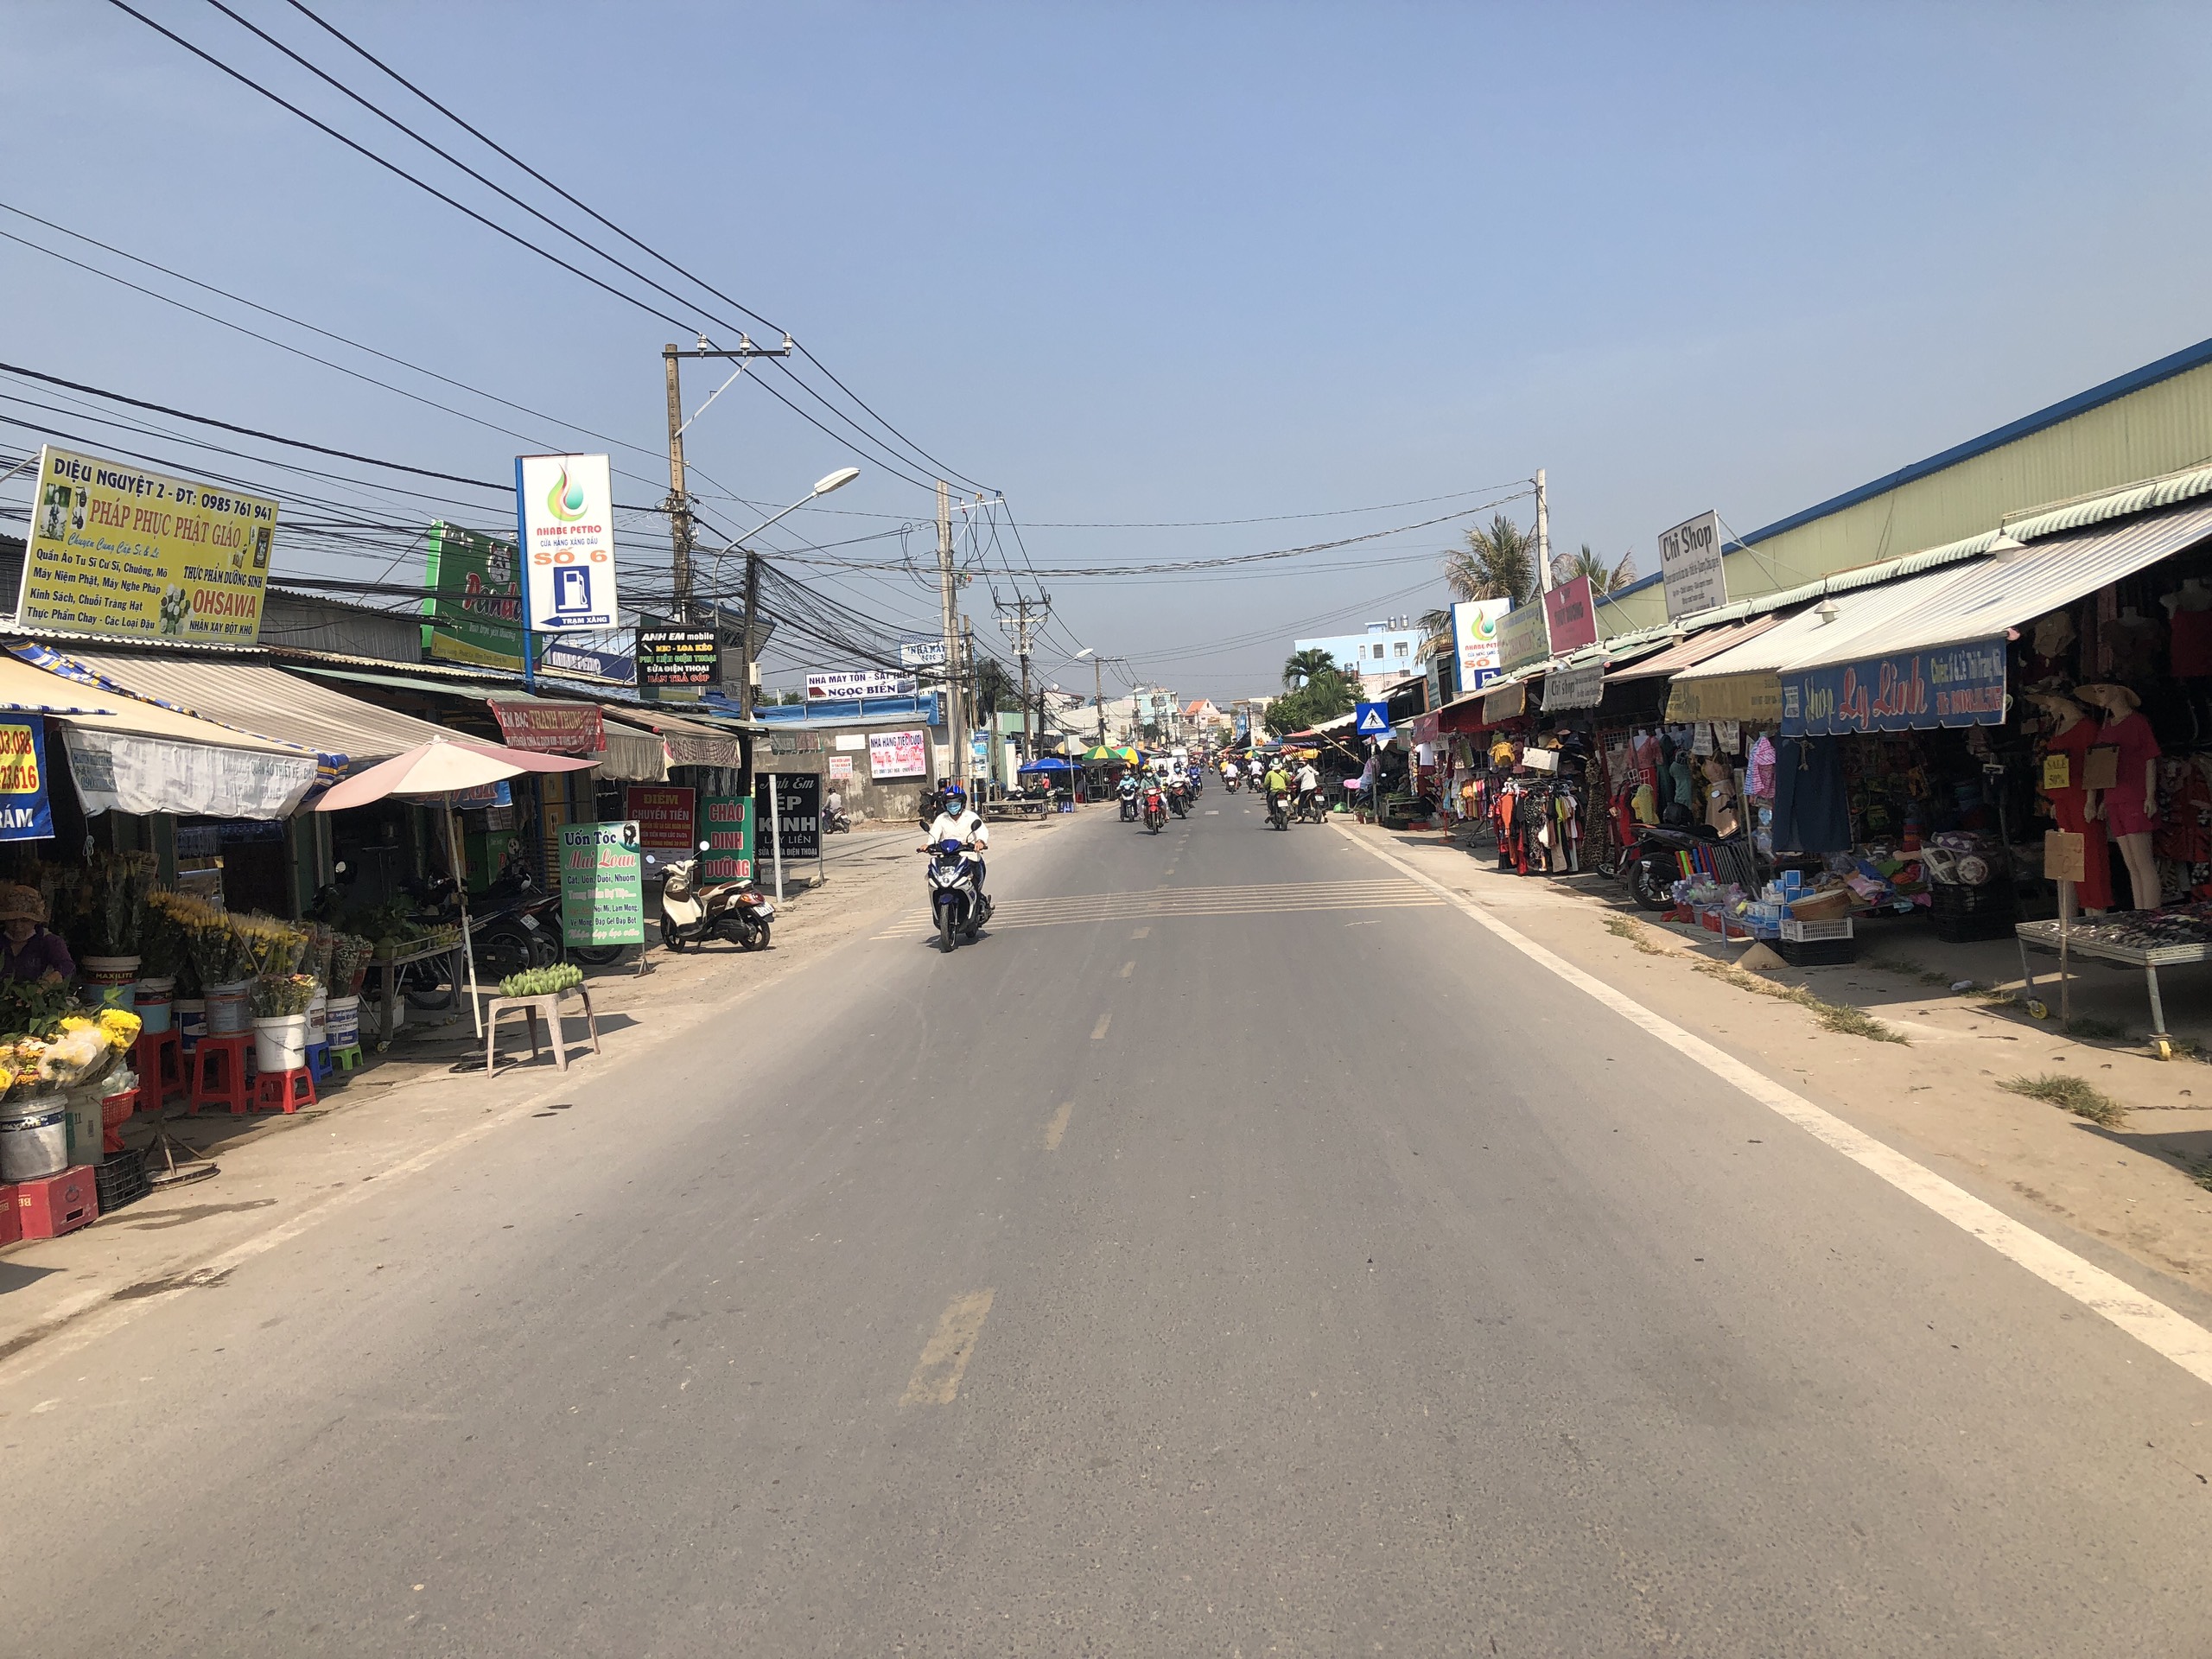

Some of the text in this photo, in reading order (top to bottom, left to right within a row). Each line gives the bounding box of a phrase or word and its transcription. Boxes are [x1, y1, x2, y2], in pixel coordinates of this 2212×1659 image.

[54, 458, 272, 521] DIỆU NGUYỆT 2 ĐT: 0985 761 941
[89, 497, 241, 549] PHÁP PHỤC PHẬT GIÁO
[537, 524, 602, 536] NHABE PETRO
[96, 537, 115, 552] Cung
[1663, 525, 1712, 562] Chi Shop
[36, 548, 59, 562] Quần
[60, 550, 73, 563] Áo
[75, 555, 86, 565] Tu
[124, 563, 154, 577] Chuông,
[534, 546, 608, 566] SỐ 6
[33, 567, 161, 595] Máy Niệm Phật, Máy Nghe Pháp
[183, 563, 263, 588] THỰC PHẨM DƯỠNG SINH
[30, 588, 143, 613] Kinh Sách, Chuỗi Tràng Hạt
[193, 588, 256, 619] OHSAWA
[27, 606, 155, 631] Thực Phẩm Chay Các Loại Đậu
[210, 621, 223, 632] XAY
[225, 621, 238, 635] BỘT
[239, 623, 253, 635] KHÔ
[562, 617, 584, 626] TRẠM
[668, 632, 685, 641] EM
[687, 632, 715, 640] mobile
[646, 664, 709, 674] SỬA ĐIỆN THOẠI
[1464, 656, 1491, 668] SỐ
[809, 675, 826, 684] NHÀ
[830, 673, 847, 683] MÁY
[828, 681, 896, 698] NGỌC BIỂN
[1840, 667, 1870, 730] Ly
[1872, 656, 1928, 717] Linh
[529, 710, 558, 729] THANH
[792, 777, 815, 790] Em
[643, 790, 678, 804] ĐIỂM
[632, 806, 666, 820] CHUYỂN
[709, 800, 745, 823] CHÁO
[564, 830, 616, 846] Uốn Tóc
[711, 831, 743, 850] DINH
[786, 847, 800, 857] ĐIỆN
[801, 848, 817, 856] THOẠI
[705, 855, 751, 878] DƯỠNG
